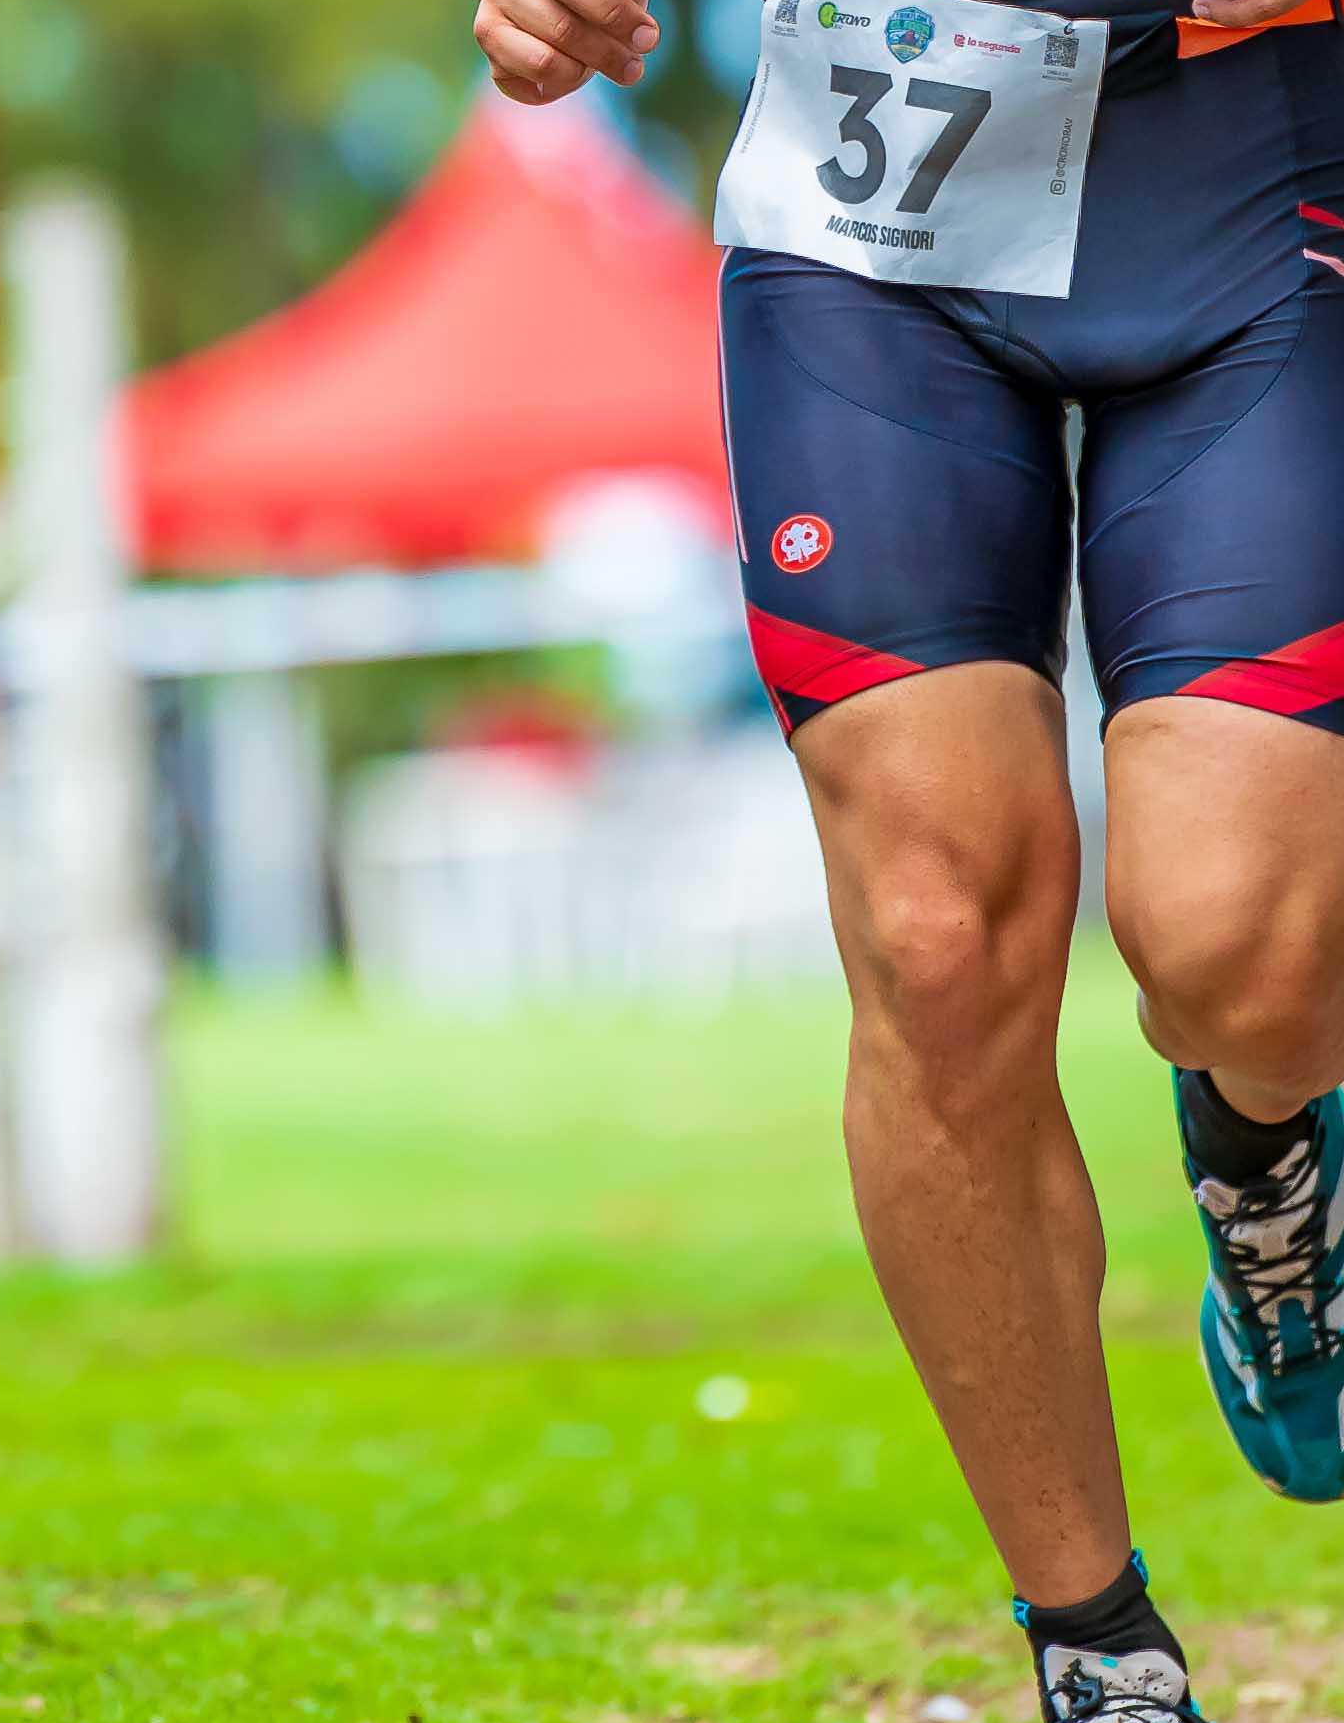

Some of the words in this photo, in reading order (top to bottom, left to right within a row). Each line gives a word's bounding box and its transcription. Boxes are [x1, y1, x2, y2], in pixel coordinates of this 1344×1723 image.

[978, 40, 1022, 55] segunda
[816, 63, 992, 214] 37
[825, 215, 878, 244] MARCOS
[879, 226, 936, 250] SIGNORI
